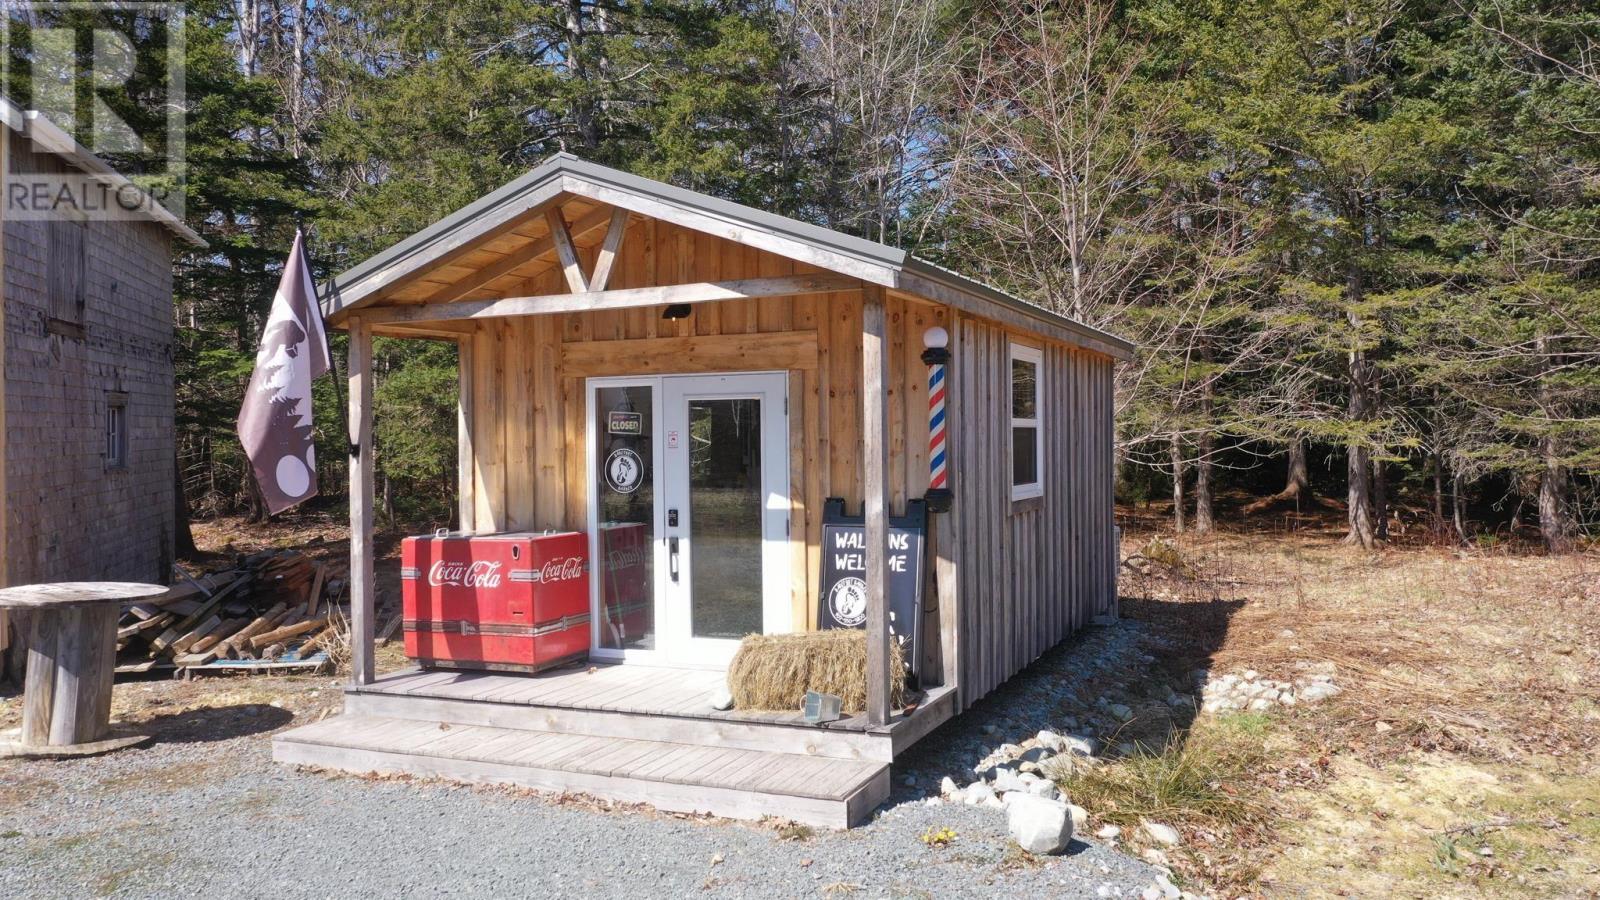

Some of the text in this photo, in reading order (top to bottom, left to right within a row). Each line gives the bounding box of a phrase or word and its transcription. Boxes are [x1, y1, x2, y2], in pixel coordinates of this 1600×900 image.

[612, 421, 639, 430] CLOSED
[835, 532, 865, 549] WAL
[540, 556, 583, 584] Coca-Cola
[835, 553, 907, 572] WELME
[428, 560, 502, 588] Coca-Cola
